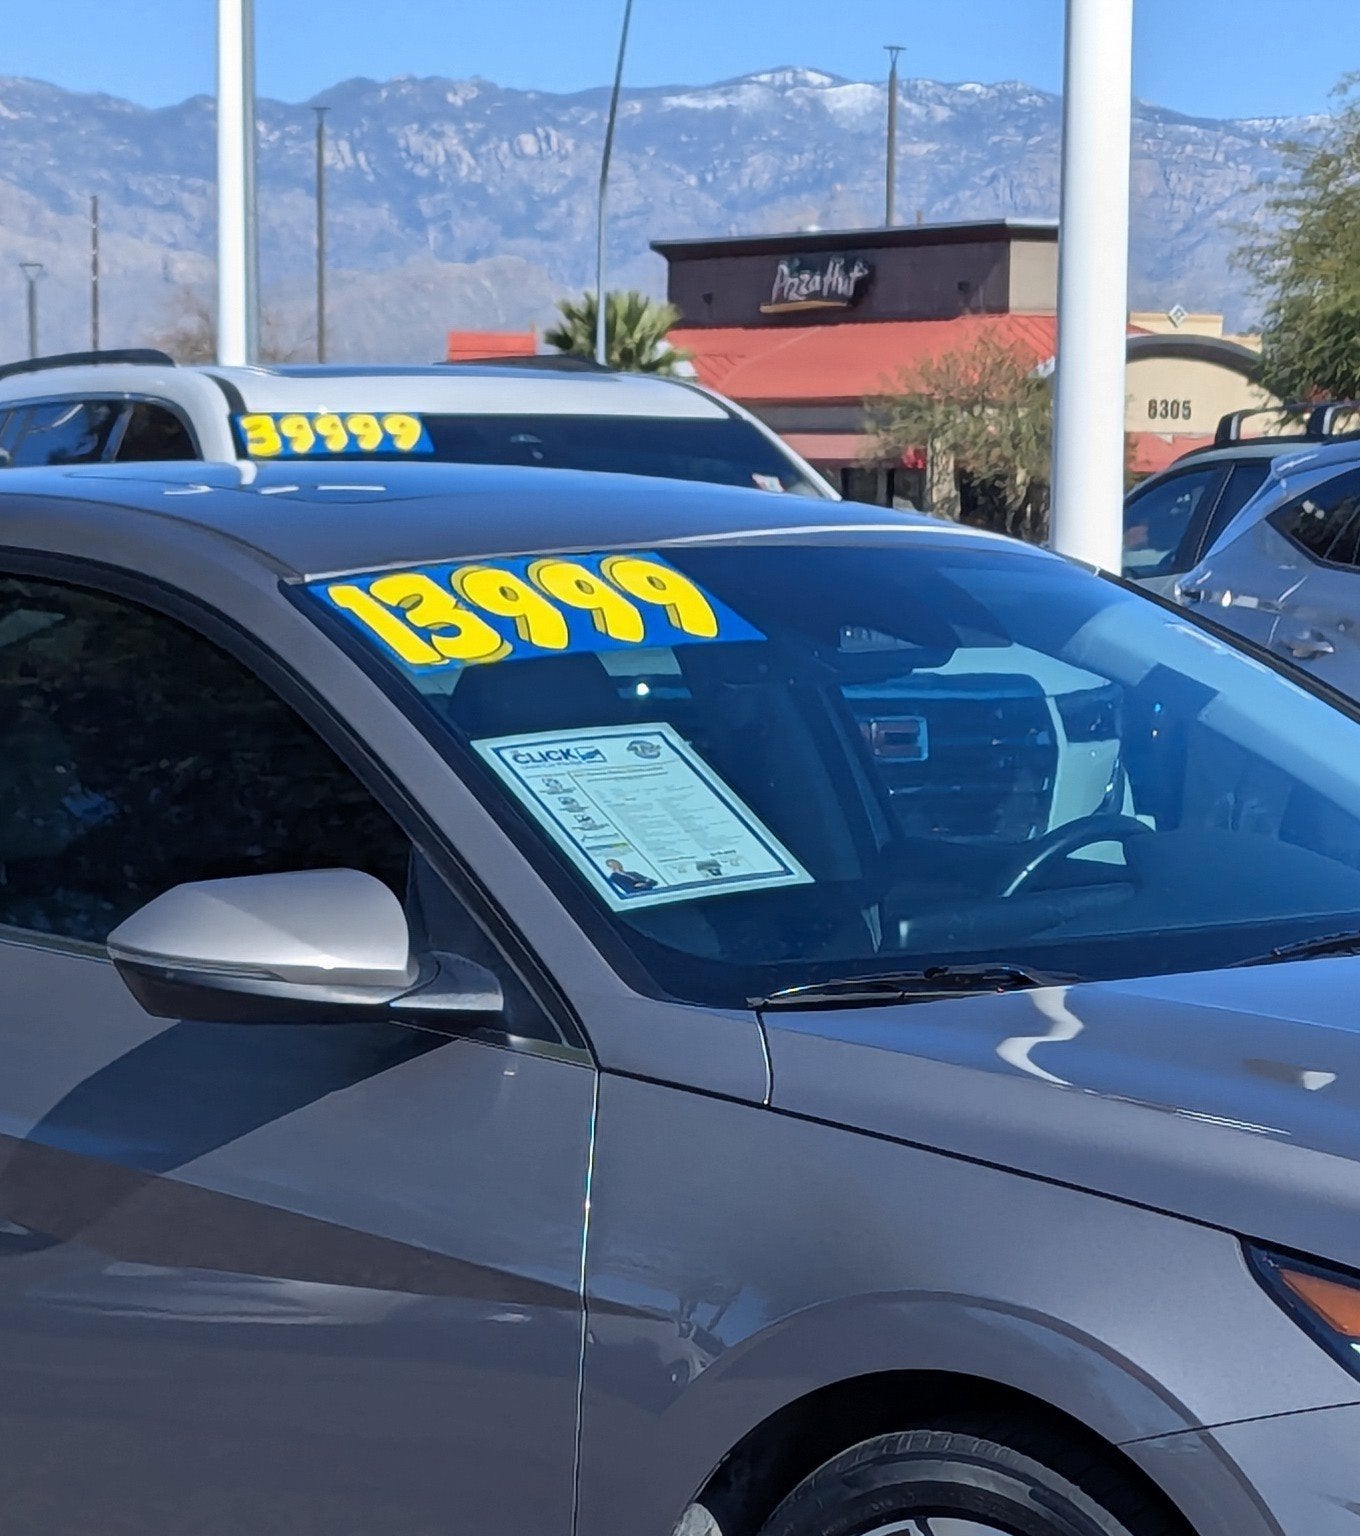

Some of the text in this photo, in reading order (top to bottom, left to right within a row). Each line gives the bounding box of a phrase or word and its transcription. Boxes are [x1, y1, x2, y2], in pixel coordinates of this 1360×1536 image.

[771, 256, 869, 303] Pizza Hut
[241, 413, 422, 457] 39999
[327, 555, 719, 665] 13999
[512, 748, 579, 765] CLICK
